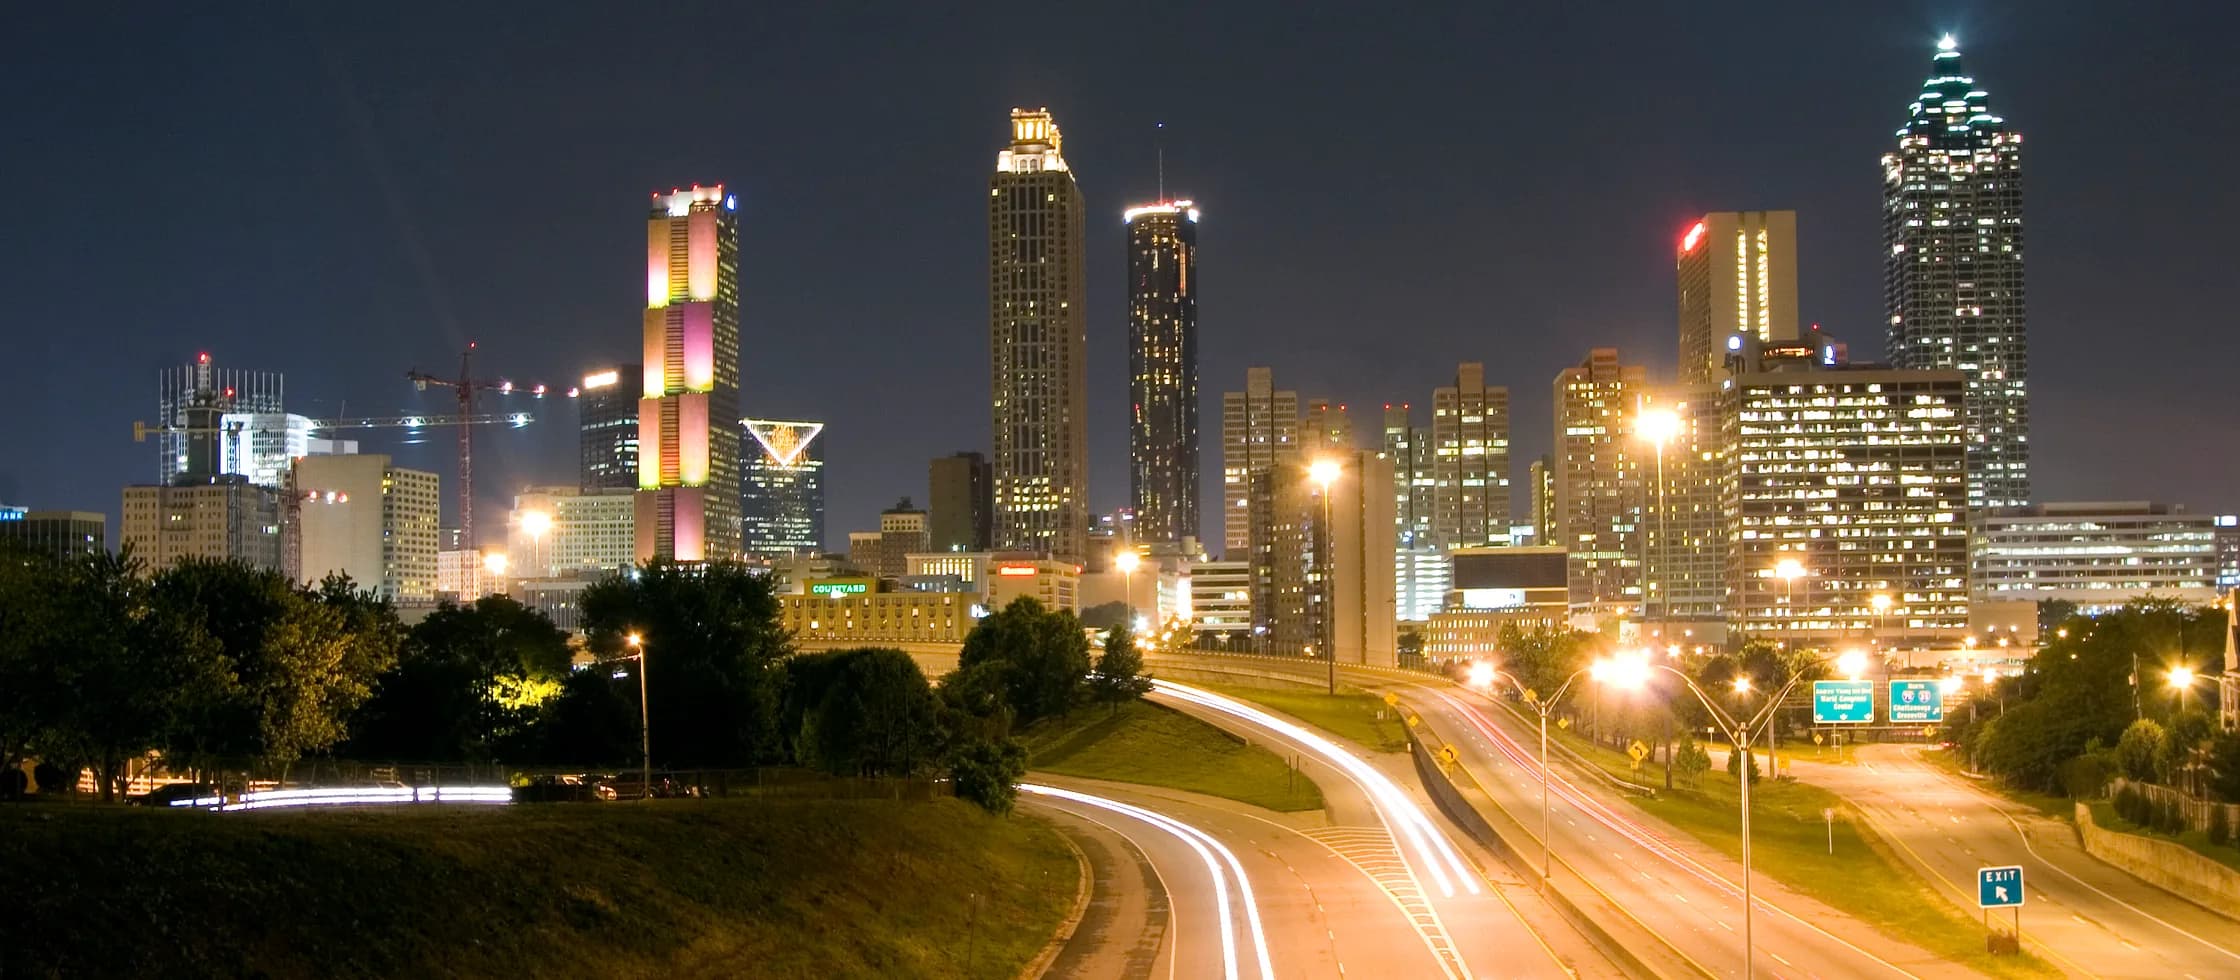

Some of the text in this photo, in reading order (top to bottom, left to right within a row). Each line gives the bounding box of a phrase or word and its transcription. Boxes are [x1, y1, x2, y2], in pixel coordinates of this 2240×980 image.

[0, 511, 23, 520] ANK
[813, 584, 866, 593] COURTYARD
[1986, 870, 2015, 882] EXIT
